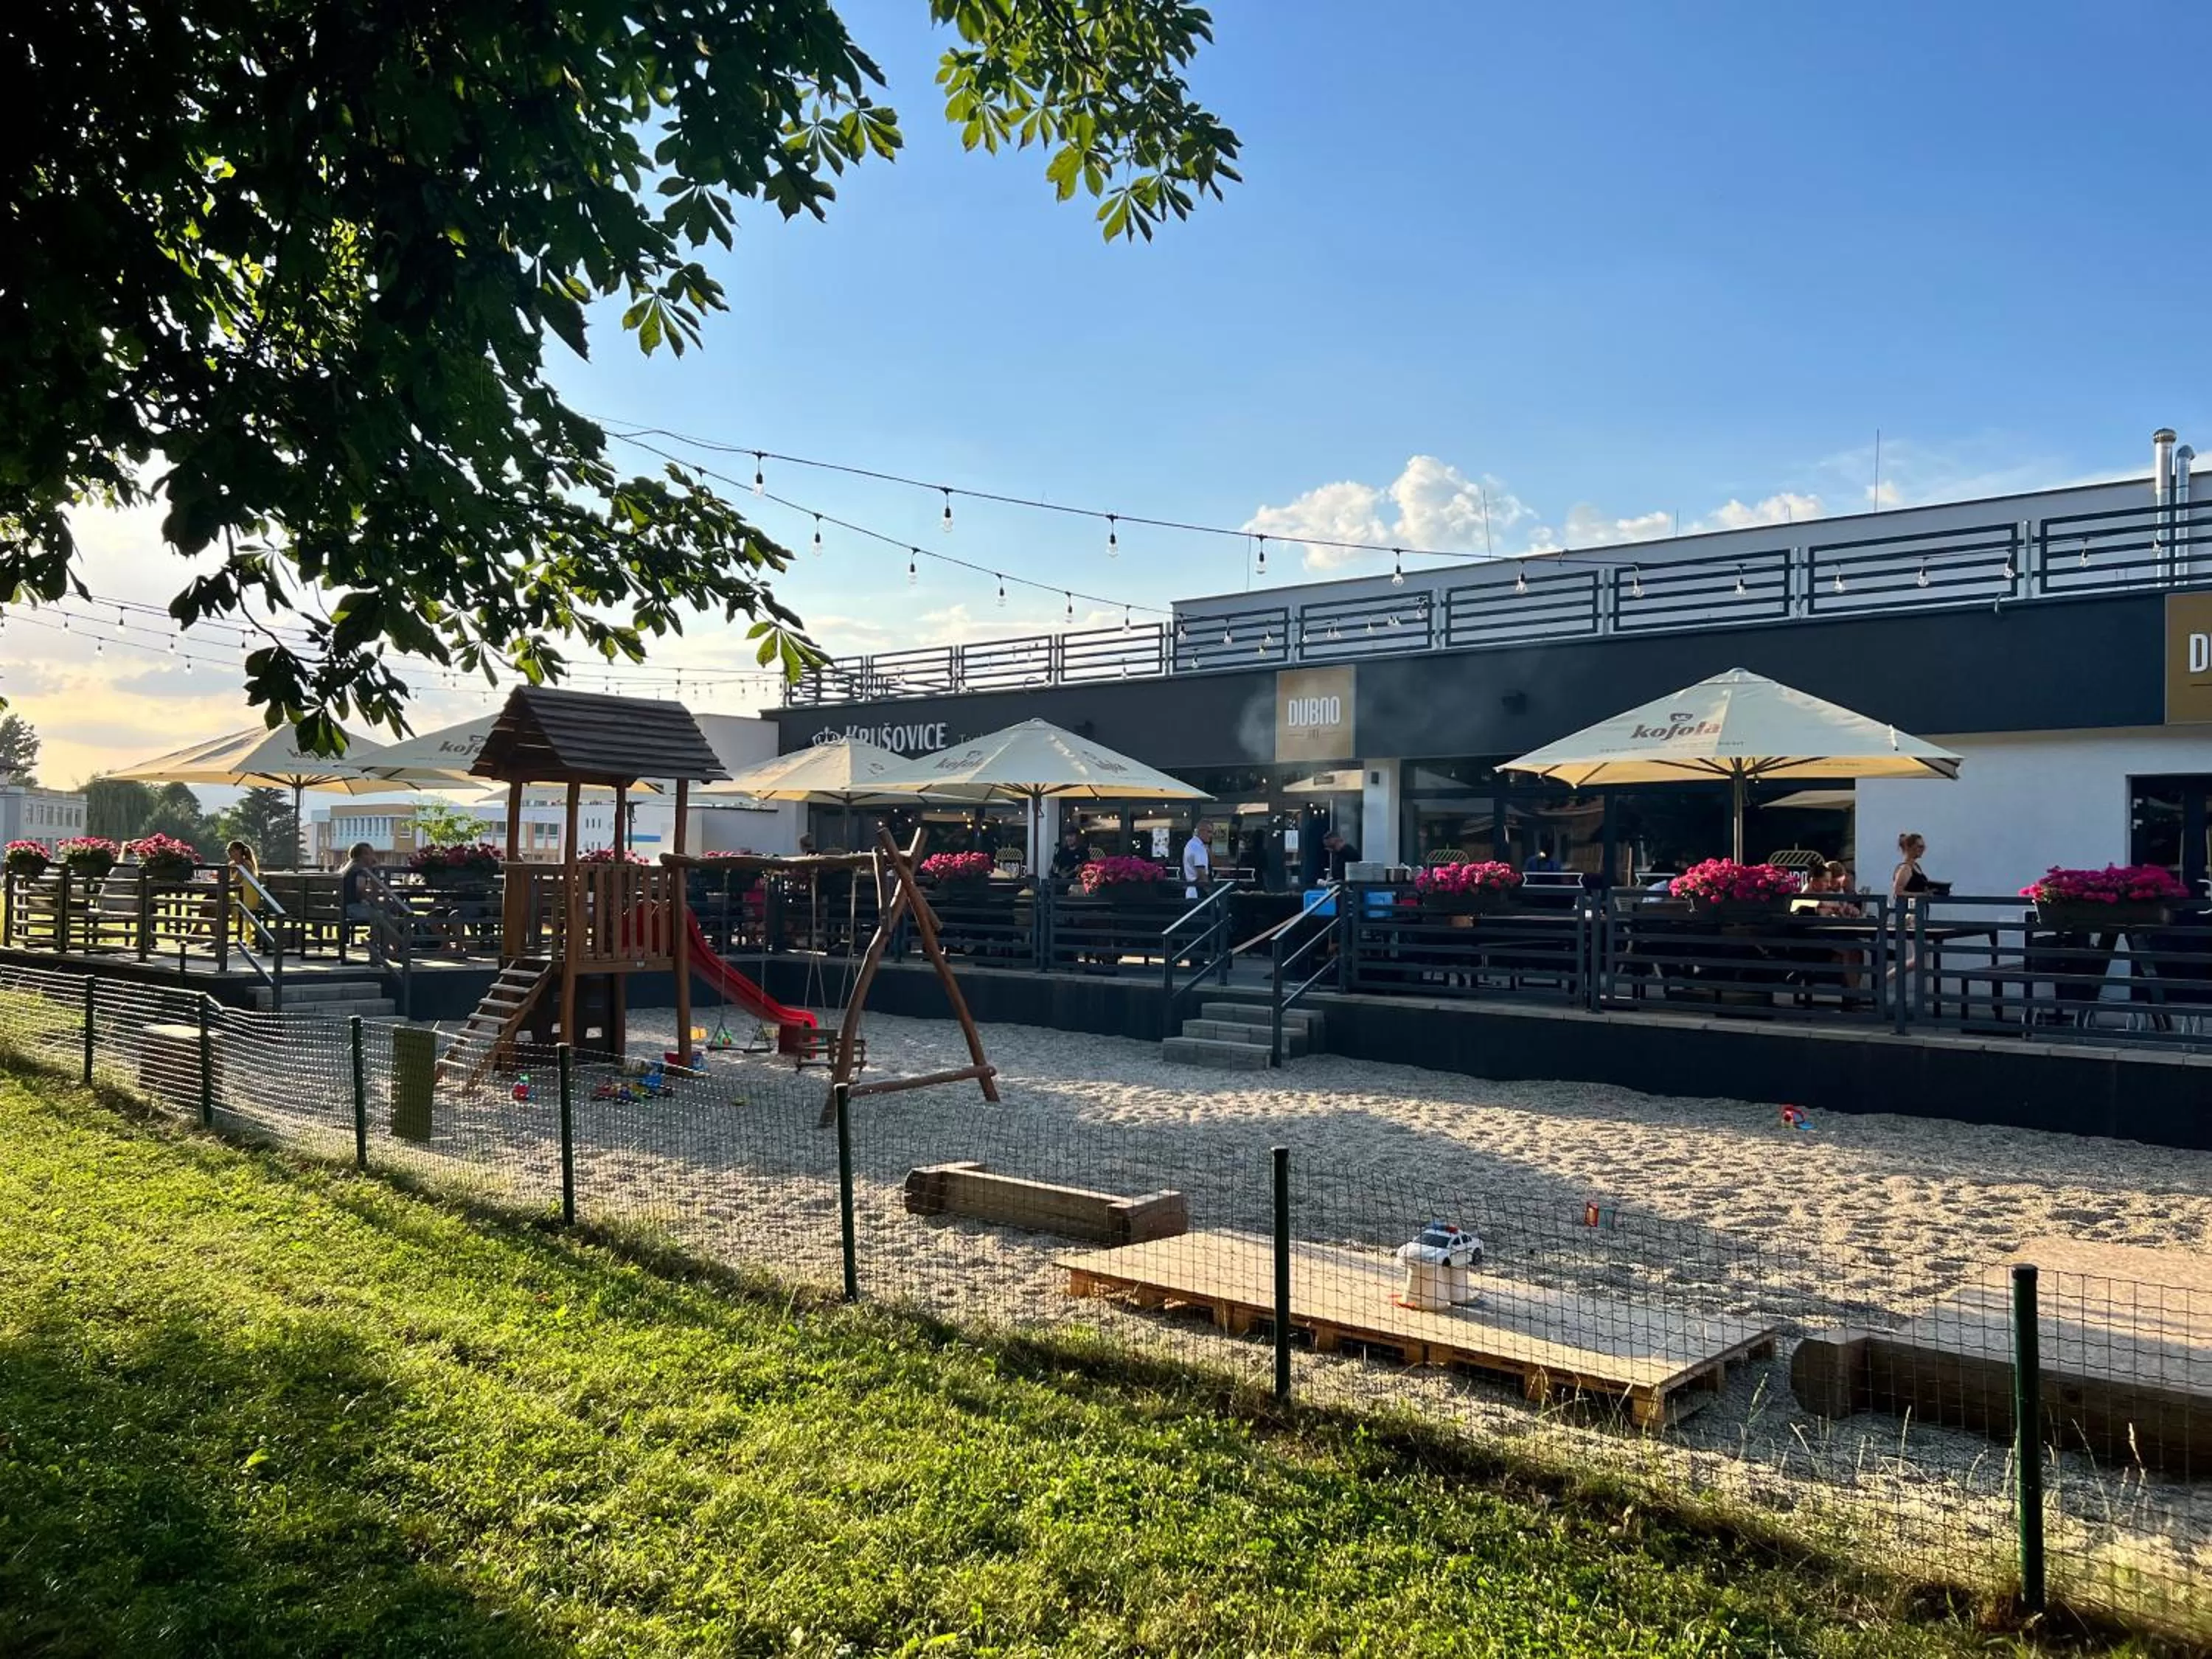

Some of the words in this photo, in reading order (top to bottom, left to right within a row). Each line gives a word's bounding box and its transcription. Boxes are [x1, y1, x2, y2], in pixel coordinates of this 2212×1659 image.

[2189, 633, 2212, 672] D
[1288, 695, 1340, 726] DUBNO
[1630, 720, 1721, 741] kofola
[439, 740, 482, 756] kofo
